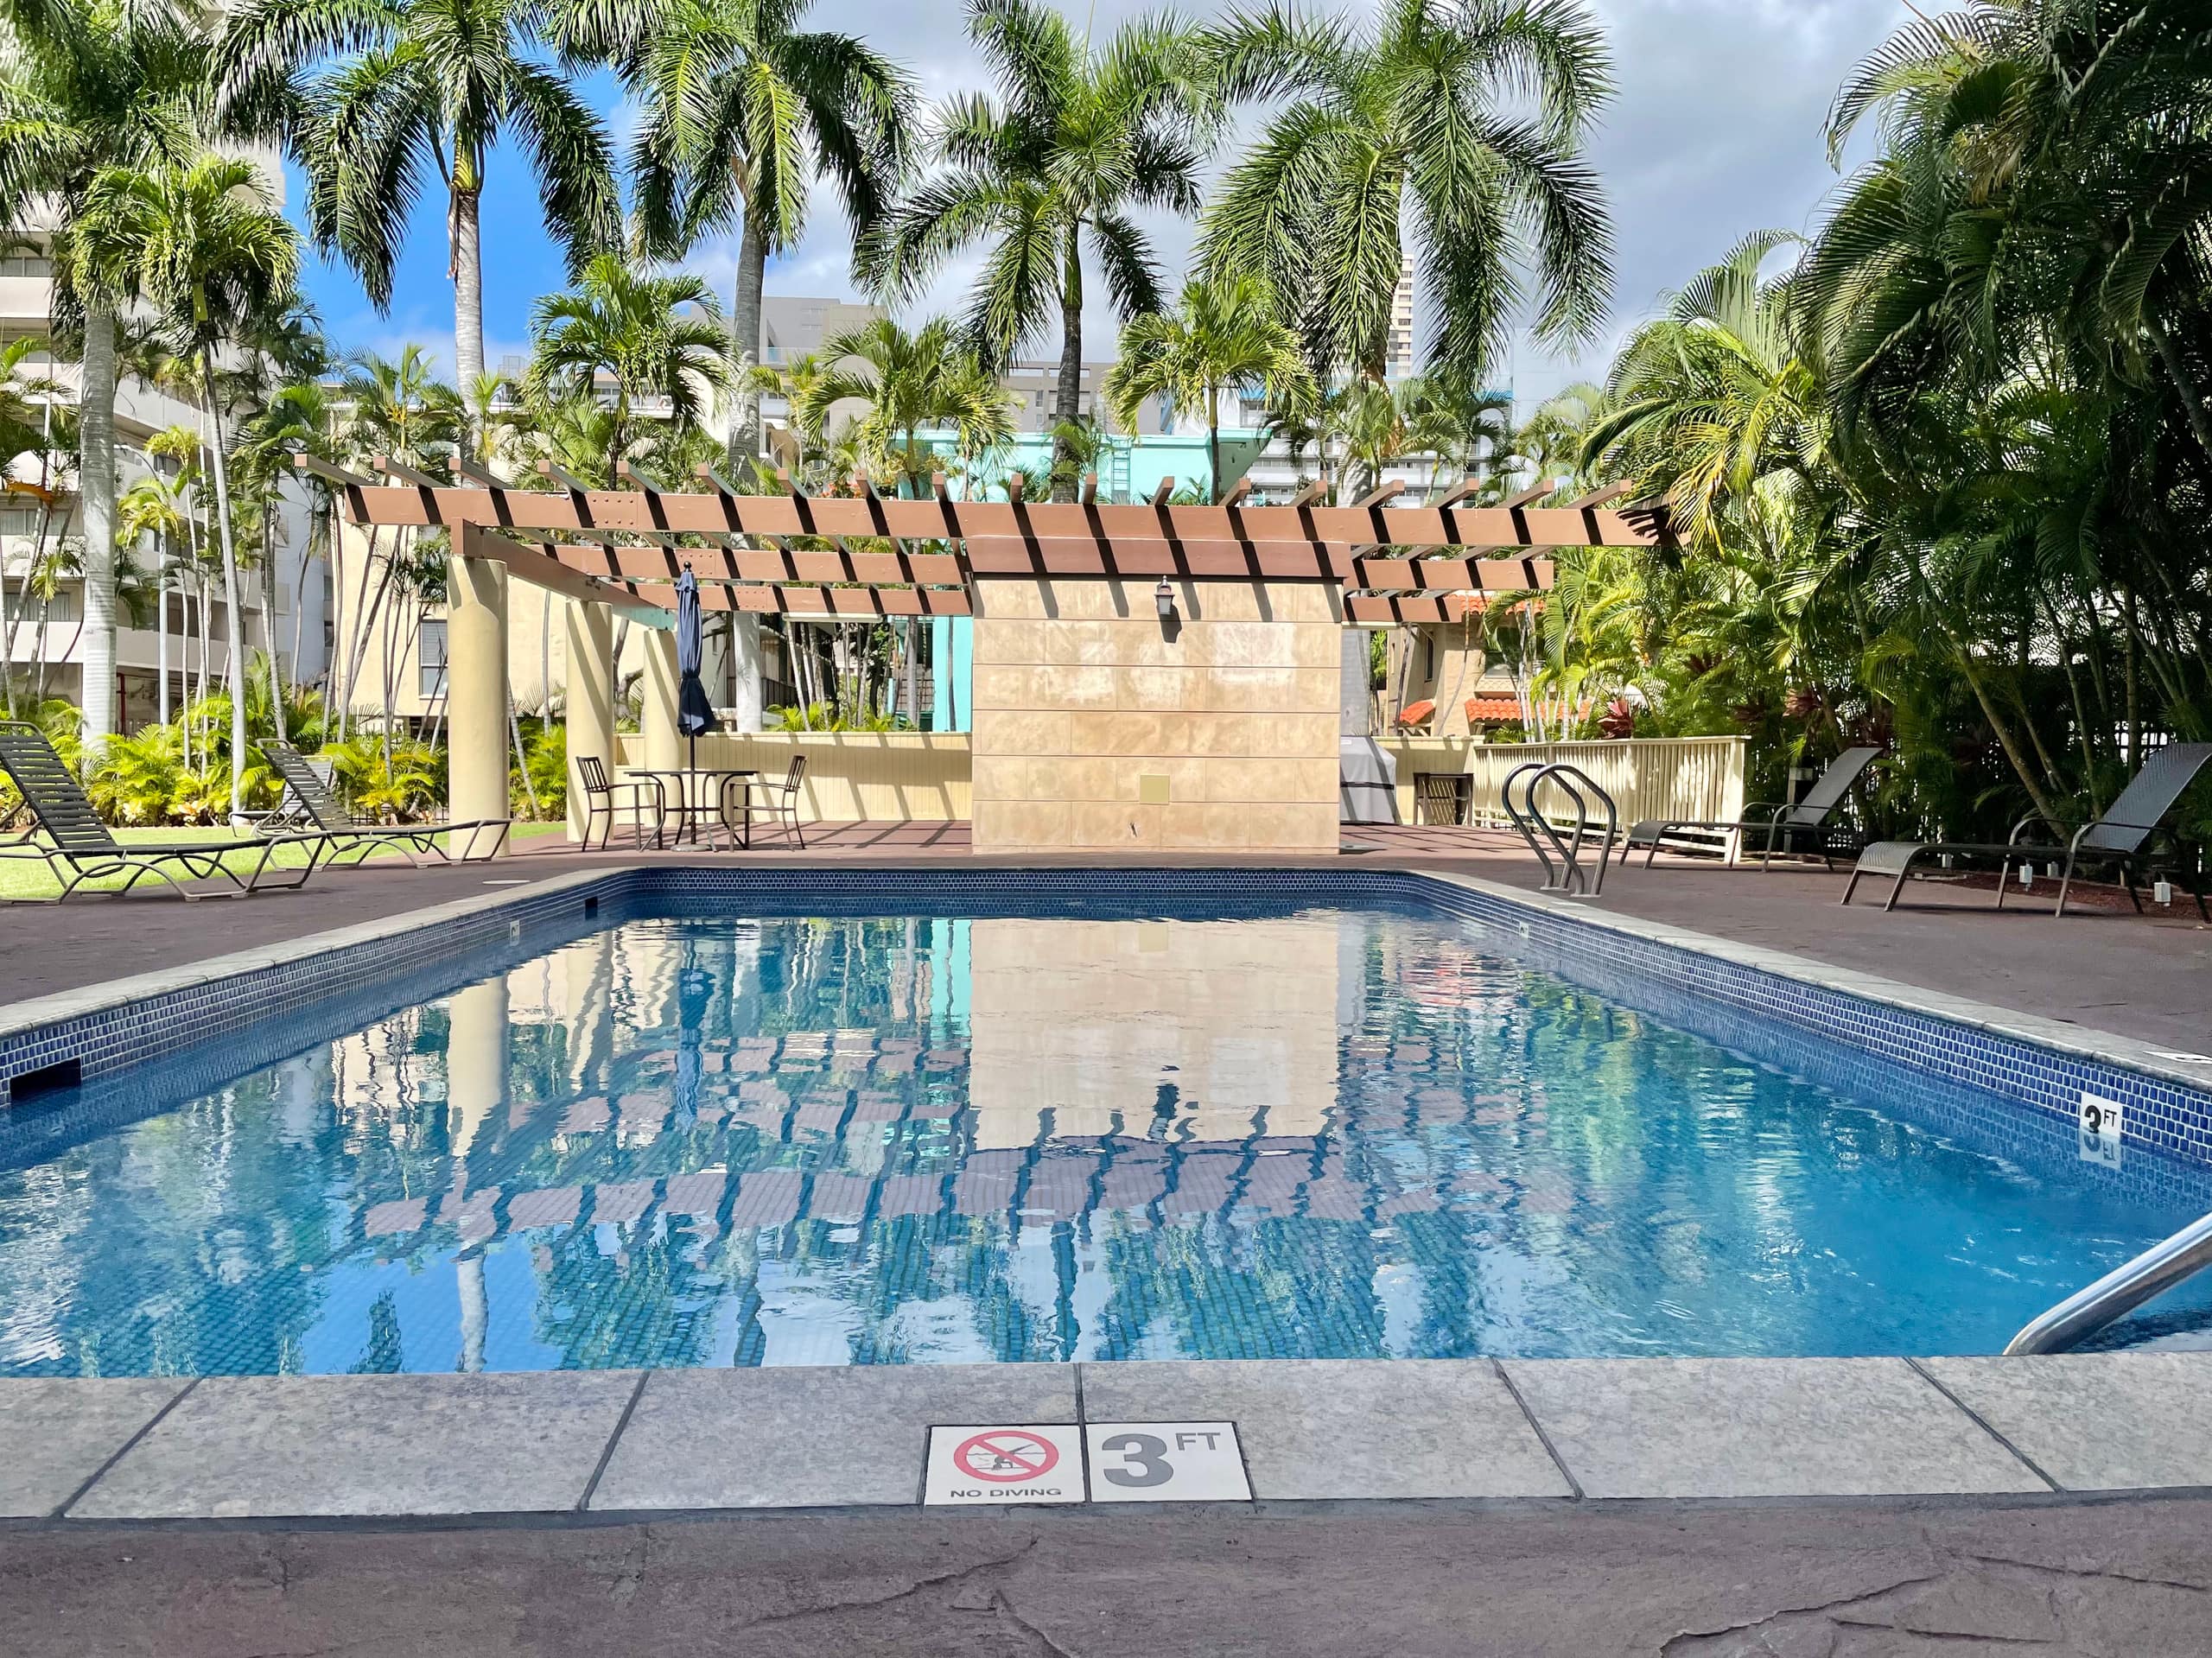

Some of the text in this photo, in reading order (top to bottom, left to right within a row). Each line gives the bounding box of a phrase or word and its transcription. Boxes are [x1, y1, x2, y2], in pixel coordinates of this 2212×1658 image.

[2104, 1109, 2117, 1127] FT
[1102, 1432, 1220, 1488] 3 FT
[950, 1488, 1062, 1498] NO DIVING
